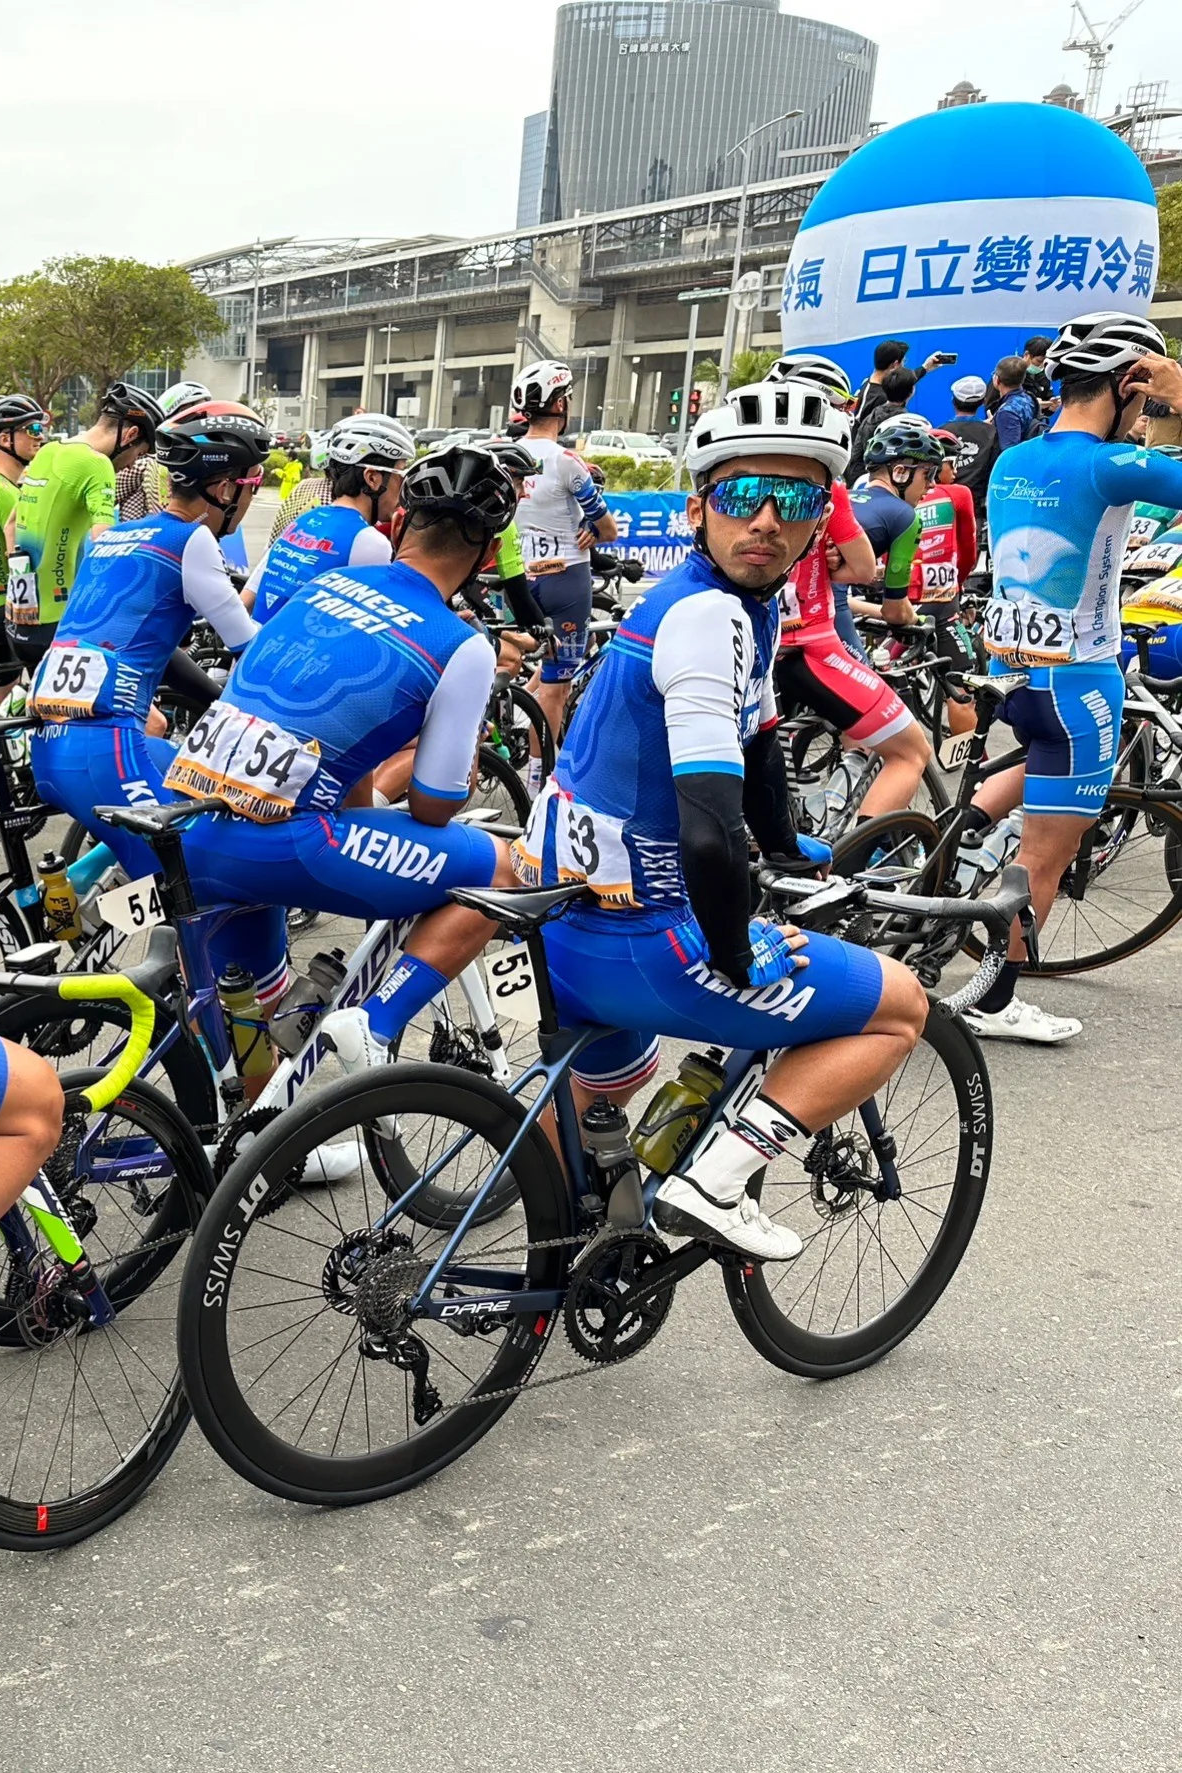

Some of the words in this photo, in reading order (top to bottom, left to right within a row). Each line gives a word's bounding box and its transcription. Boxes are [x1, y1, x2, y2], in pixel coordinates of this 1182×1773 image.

[856, 233, 1155, 304] 日立變頻冷氣
[200, 415, 265, 431] RUDY
[52, 527, 70, 586] advarics
[88, 541, 142, 558] TAIPEI
[273, 543, 320, 566] DARE
[531, 536, 560, 558] 151
[1098, 534, 1113, 582] System
[806, 557, 821, 600] Champion
[926, 565, 956, 588] 204
[304, 588, 392, 637] TAIPEI
[314, 572, 426, 630] CHINESE
[1092, 583, 1107, 632] Champion
[1026, 610, 1063, 648] 62
[52, 653, 91, 694] 55
[823, 652, 850, 675] HONG
[850, 666, 880, 690] KONG
[186, 708, 231, 760] 54
[1079, 688, 1112, 727] HONG
[1097, 726, 1114, 763] KONG
[244, 729, 299, 788] 54
[949, 738, 973, 765] 162
[1074, 784, 1109, 797] HKG
[339, 822, 449, 887] KENDA
[127, 886, 163, 928] 54
[375, 965, 413, 1005] CHINESE
[491, 950, 534, 999] 53
[965, 1071, 988, 1135] SWISS
[116, 1164, 163, 1178] REACTO
[969, 1141, 986, 1180] DT
[238, 1172, 270, 1223] DT
[203, 1223, 242, 1309] SWISS
[440, 1299, 512, 1318] DARE
